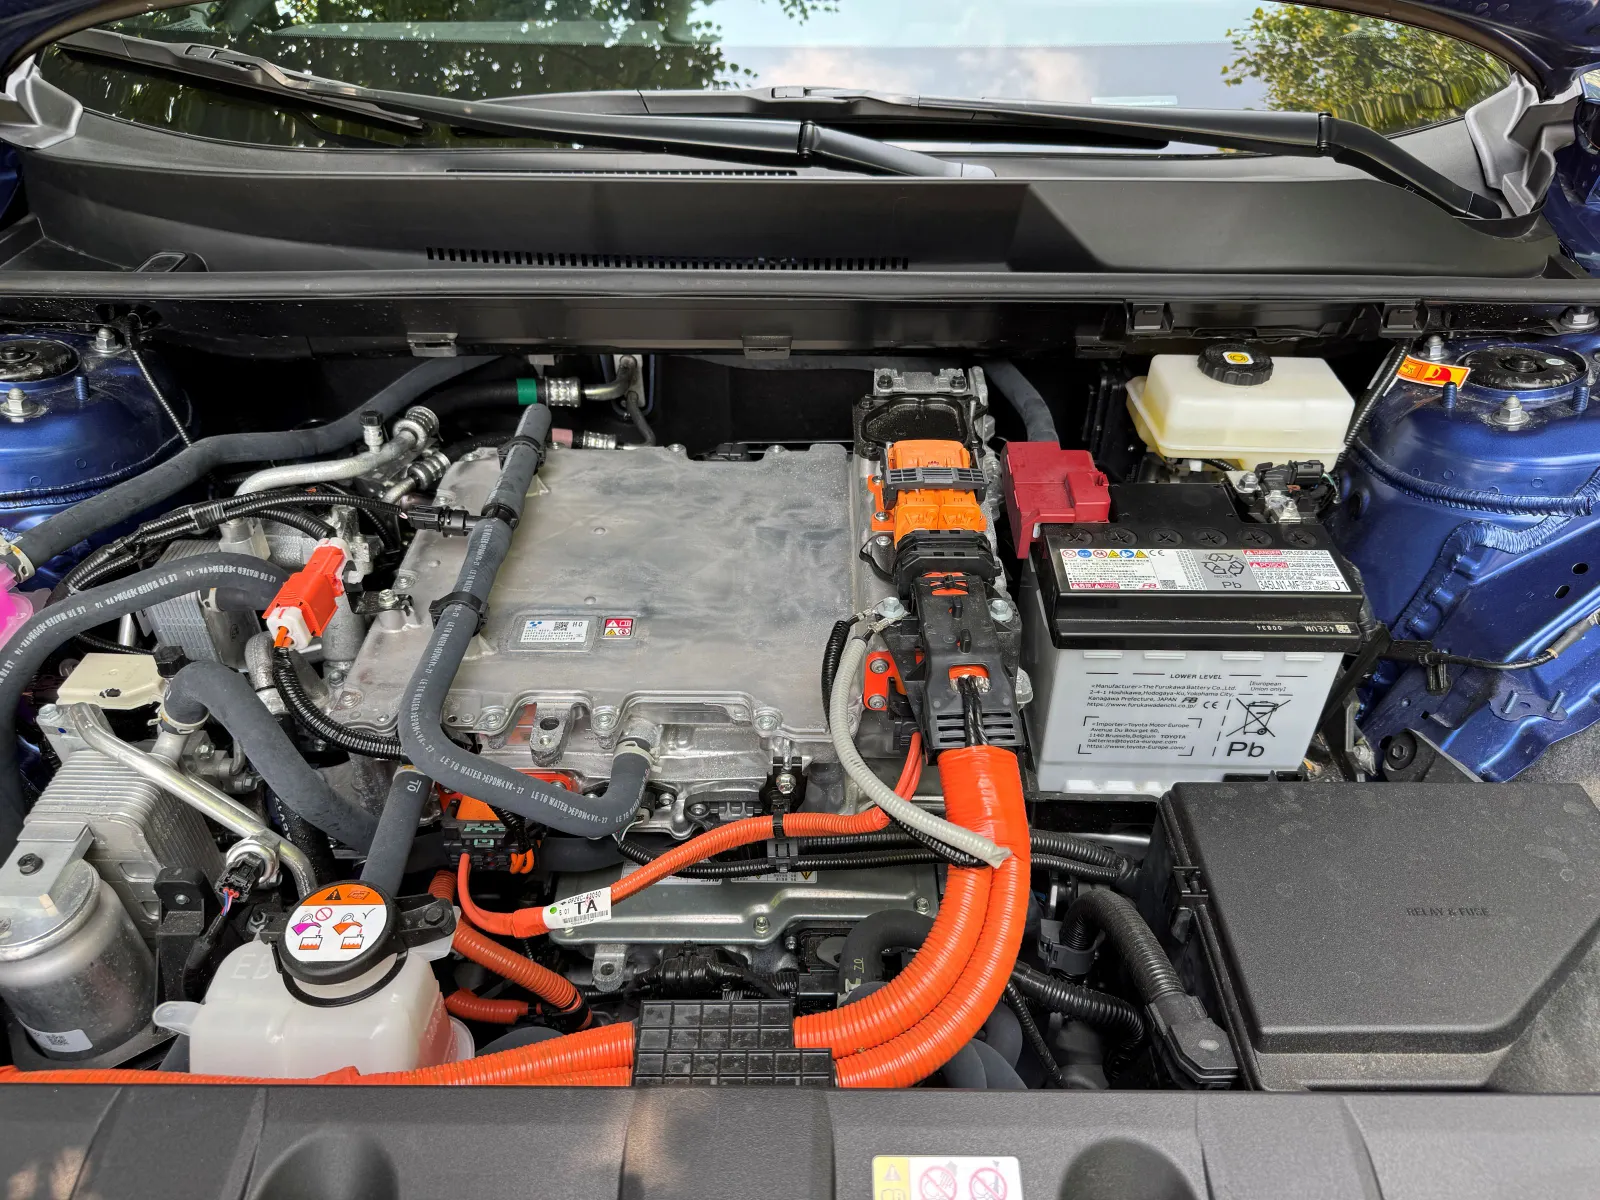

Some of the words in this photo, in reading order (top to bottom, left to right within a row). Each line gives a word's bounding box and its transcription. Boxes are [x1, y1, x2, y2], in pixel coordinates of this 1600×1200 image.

[237, 567, 259, 577] WATER
[137, 581, 159, 594] WATER
[1221, 581, 1242, 589] Pb
[45, 613, 67, 626] WATER
[411, 694, 421, 711] WATER
[1226, 741, 1265, 758] Pb
[460, 766, 482, 779] WATER
[531, 791, 539, 800] LE
[549, 797, 568, 812] WATER
[573, 899, 598, 915] TA
[1406, 907, 1443, 916] RELAY
[1459, 907, 1489, 916] FUSE
